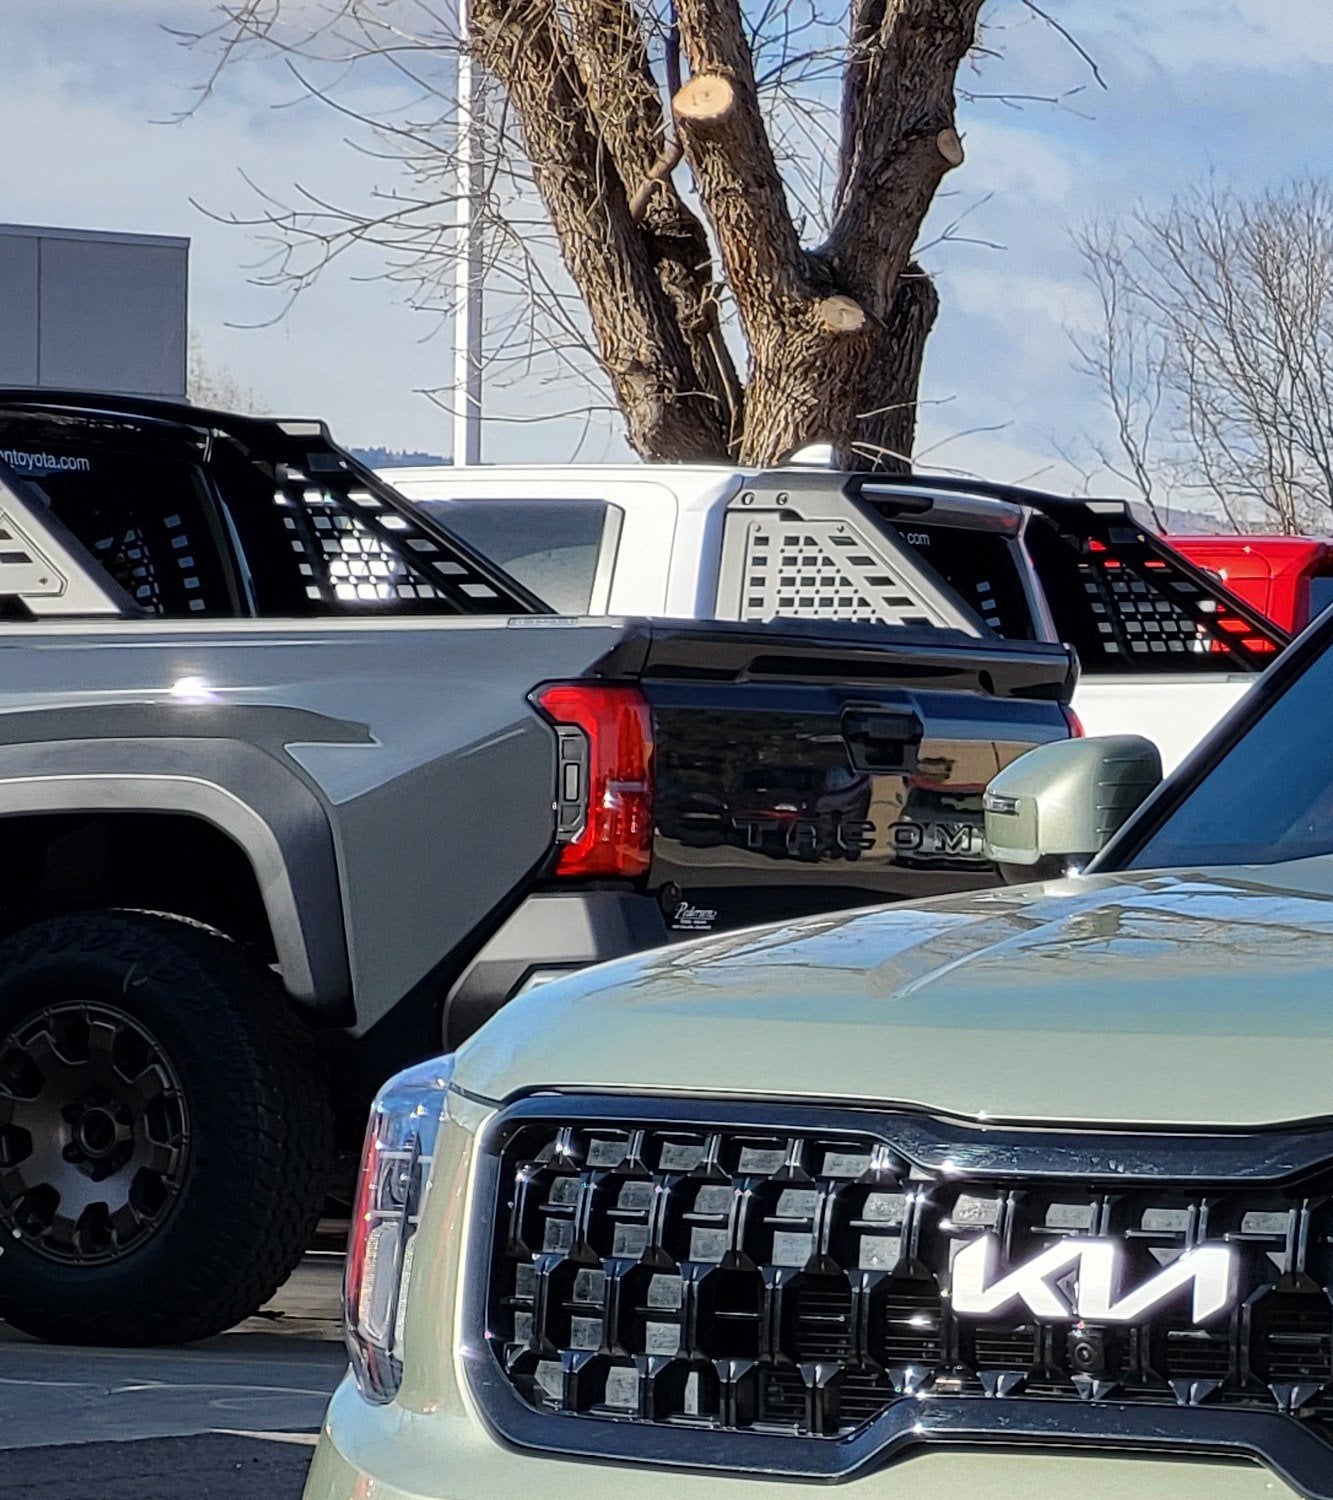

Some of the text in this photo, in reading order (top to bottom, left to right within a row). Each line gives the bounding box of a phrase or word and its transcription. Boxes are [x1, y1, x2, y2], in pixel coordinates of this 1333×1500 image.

[0, 449, 91, 471] ntoyota.com
[732, 815, 980, 855] TACOM
[952, 1234, 1230, 1323] KIA
